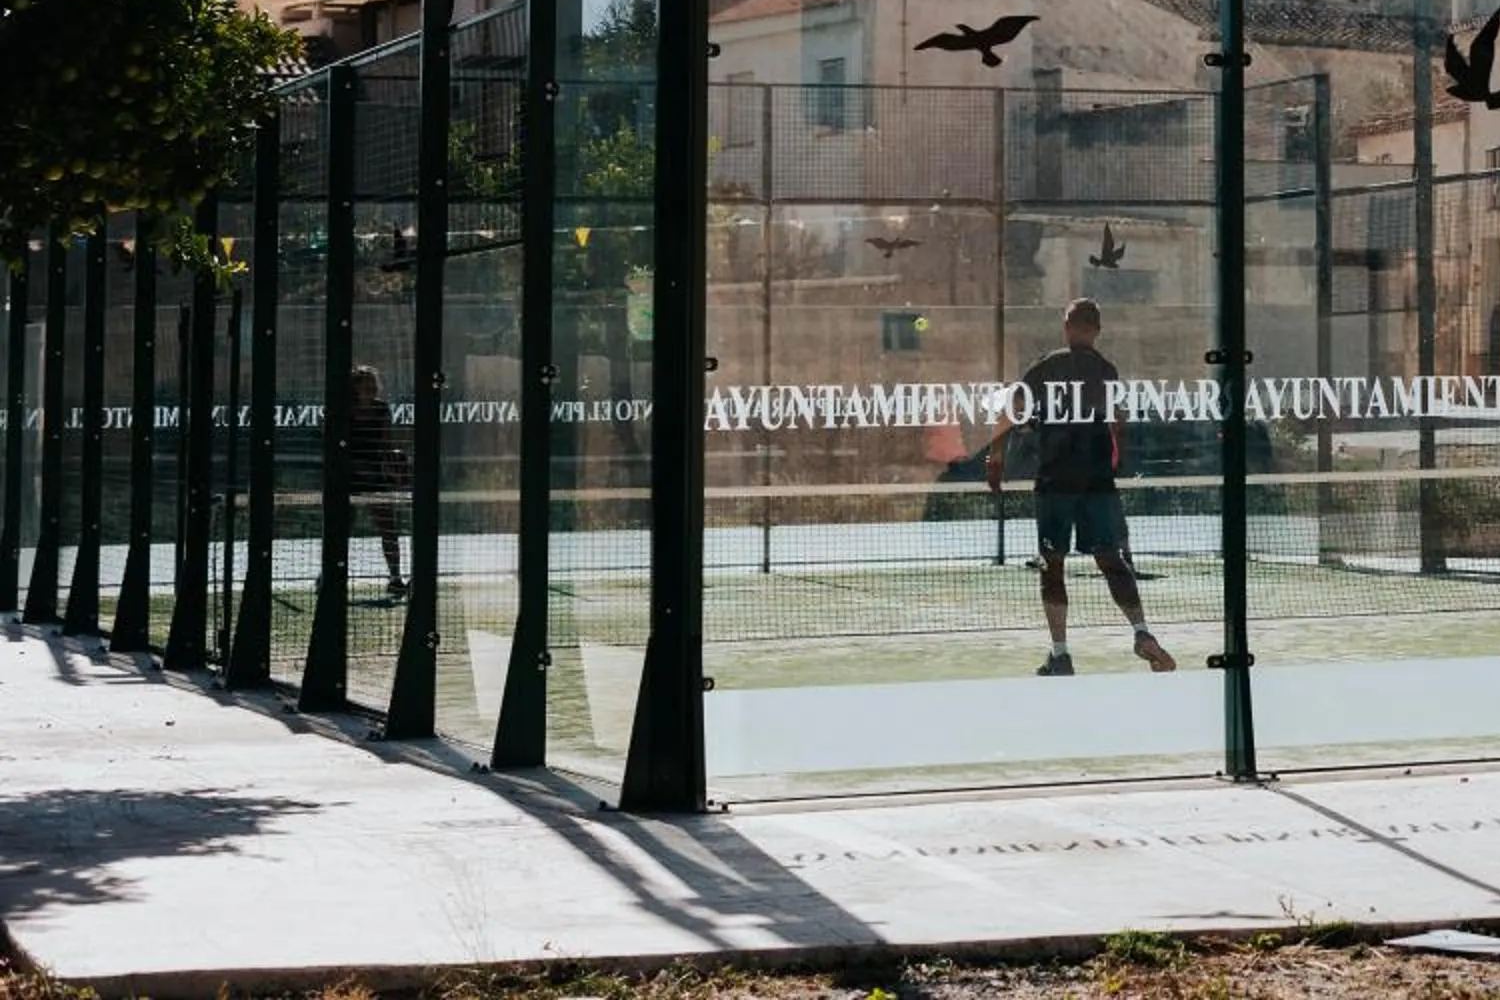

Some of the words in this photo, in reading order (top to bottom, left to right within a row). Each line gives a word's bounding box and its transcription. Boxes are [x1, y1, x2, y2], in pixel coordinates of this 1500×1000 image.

[704, 381, 1035, 431] AYUNTAMIENTO
[1044, 381, 1095, 425] EL
[1103, 379, 1225, 424] PINAR
